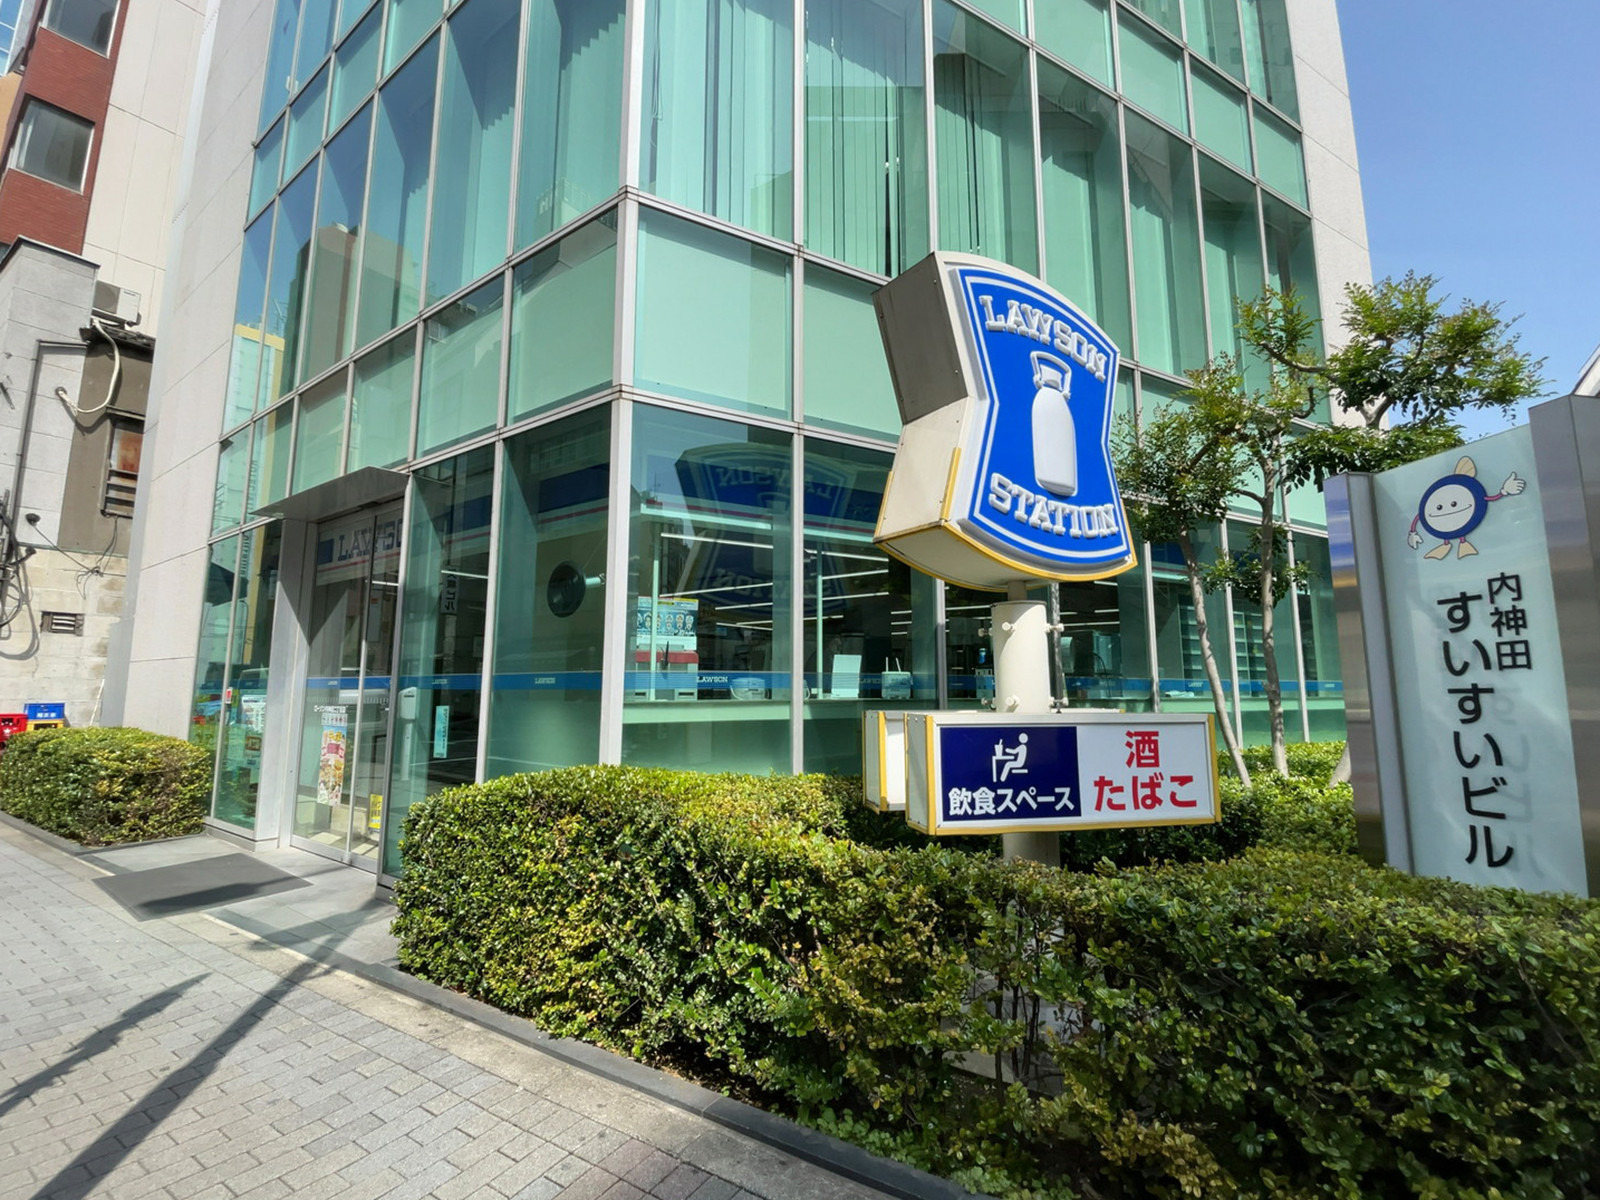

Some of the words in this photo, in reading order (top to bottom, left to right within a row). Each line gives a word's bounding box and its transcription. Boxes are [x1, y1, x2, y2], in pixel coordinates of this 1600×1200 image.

[978, 294, 1108, 383] LAWSON
[990, 472, 1119, 538] STATION
[1487, 572, 1532, 671] 内神田
[696, 676, 728, 684] LAWSON
[1125, 730, 1160, 768] 酒
[1437, 591, 1514, 868] すいすいビル
[948, 787, 1075, 815] 飲食スペース
[1093, 772, 1197, 812] たばこ
